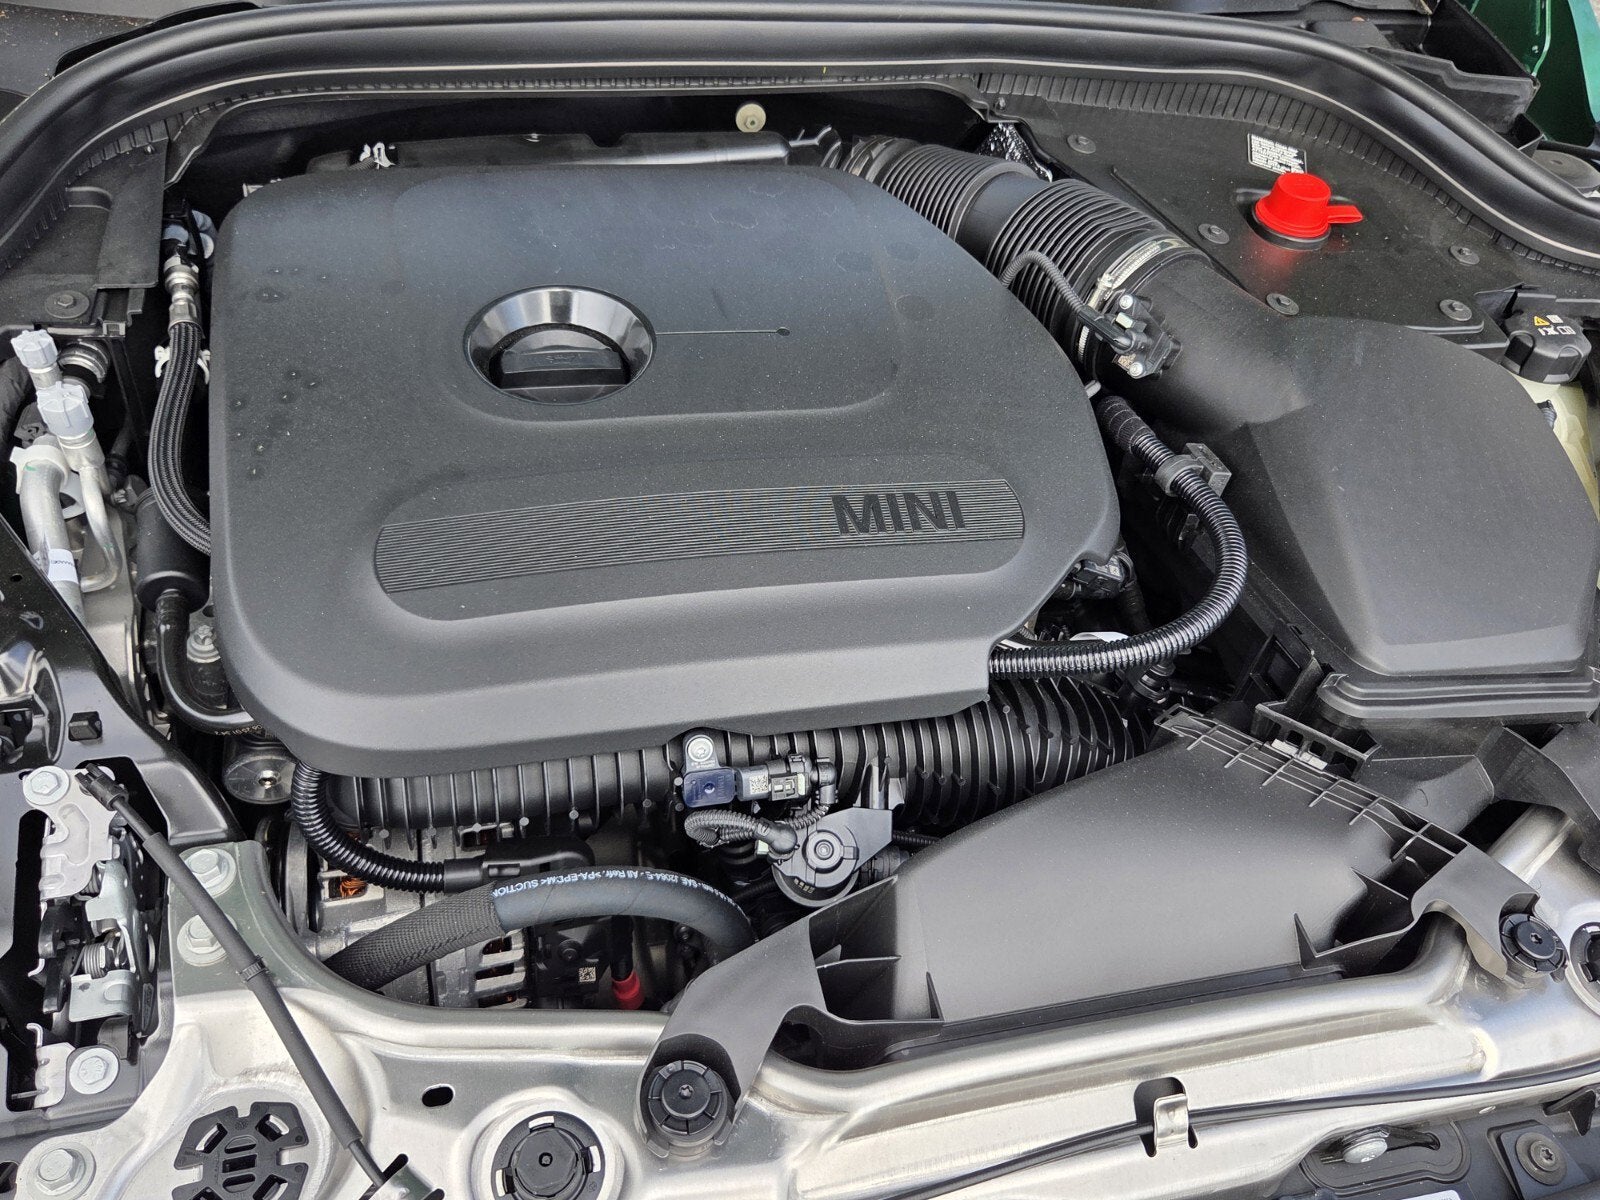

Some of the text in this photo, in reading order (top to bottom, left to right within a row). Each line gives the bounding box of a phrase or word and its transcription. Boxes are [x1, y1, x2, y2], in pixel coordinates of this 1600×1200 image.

[832, 491, 966, 534] MINI
[492, 879, 539, 897] SUCTION
[681, 876, 698, 888] SAE
